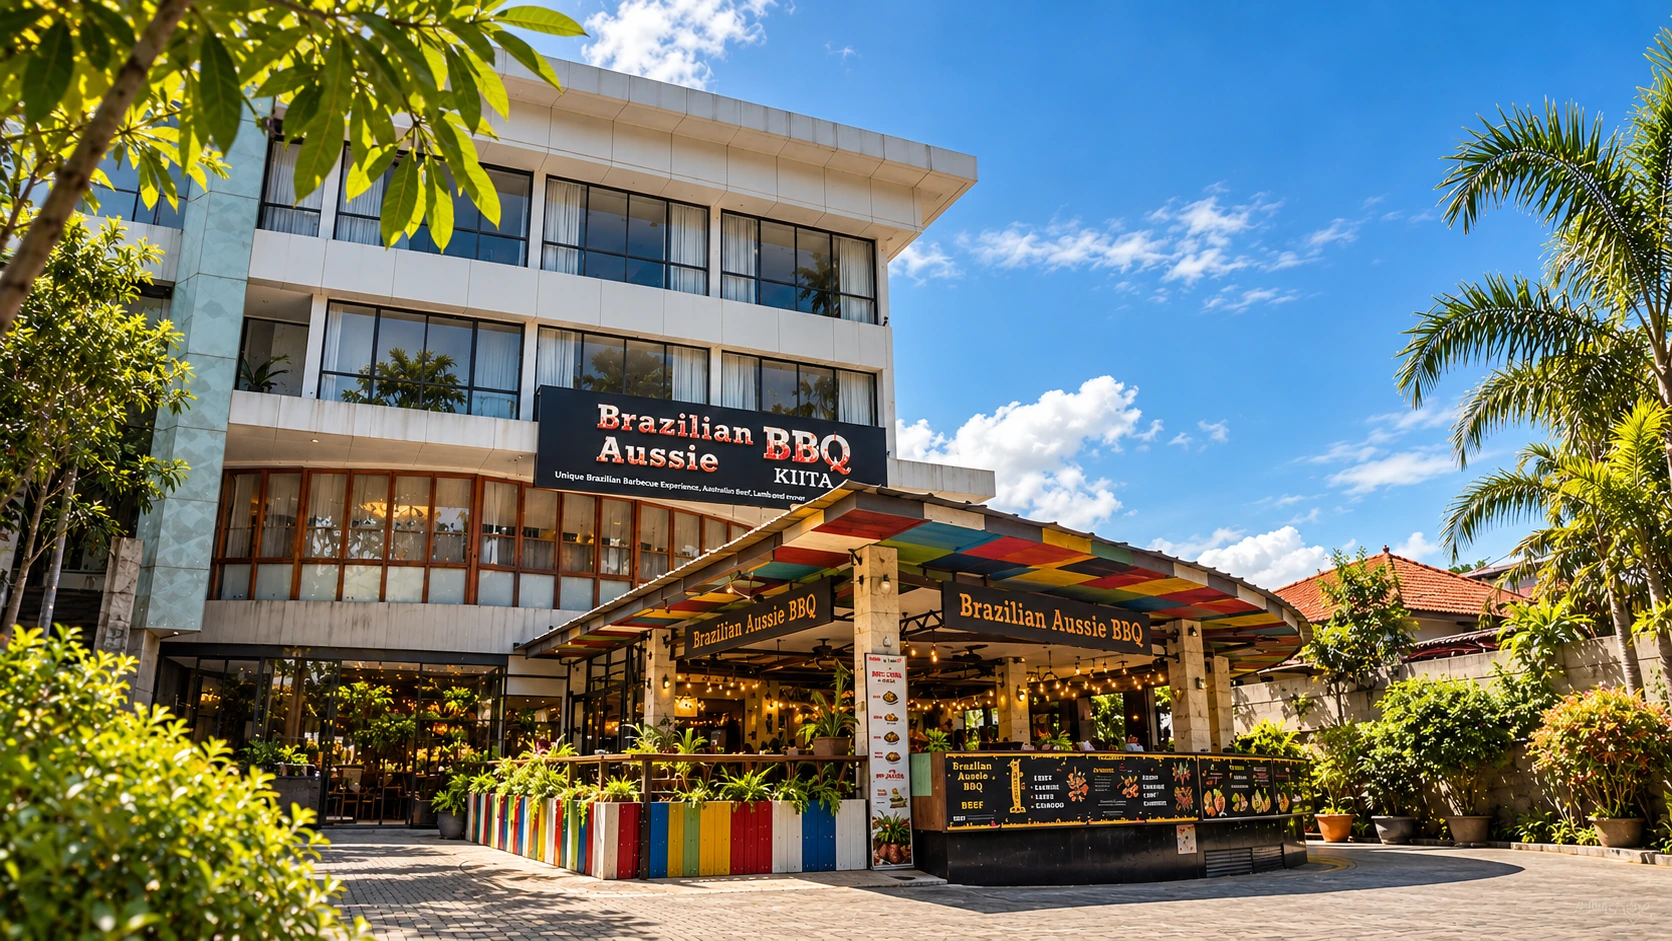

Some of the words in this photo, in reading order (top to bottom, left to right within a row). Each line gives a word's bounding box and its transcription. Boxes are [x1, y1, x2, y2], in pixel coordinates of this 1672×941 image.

[596, 403, 754, 446] Brazilian
[596, 435, 719, 473] Aussie
[762, 425, 852, 476] BBQ
[554, 470, 585, 482] Unique
[586, 473, 622, 484] Brazilian
[623, 477, 659, 488] Barbecue
[773, 467, 834, 489] KIITA
[693, 621, 742, 648] Brazilian
[746, 605, 784, 634] Aussie
[789, 594, 816, 621] BBQ
[959, 592, 1047, 629] Brazilian
[1051, 609, 1107, 639] Aussie
[1110, 618, 1144, 648] BBQ
[961, 801, 984, 810] BEEF
